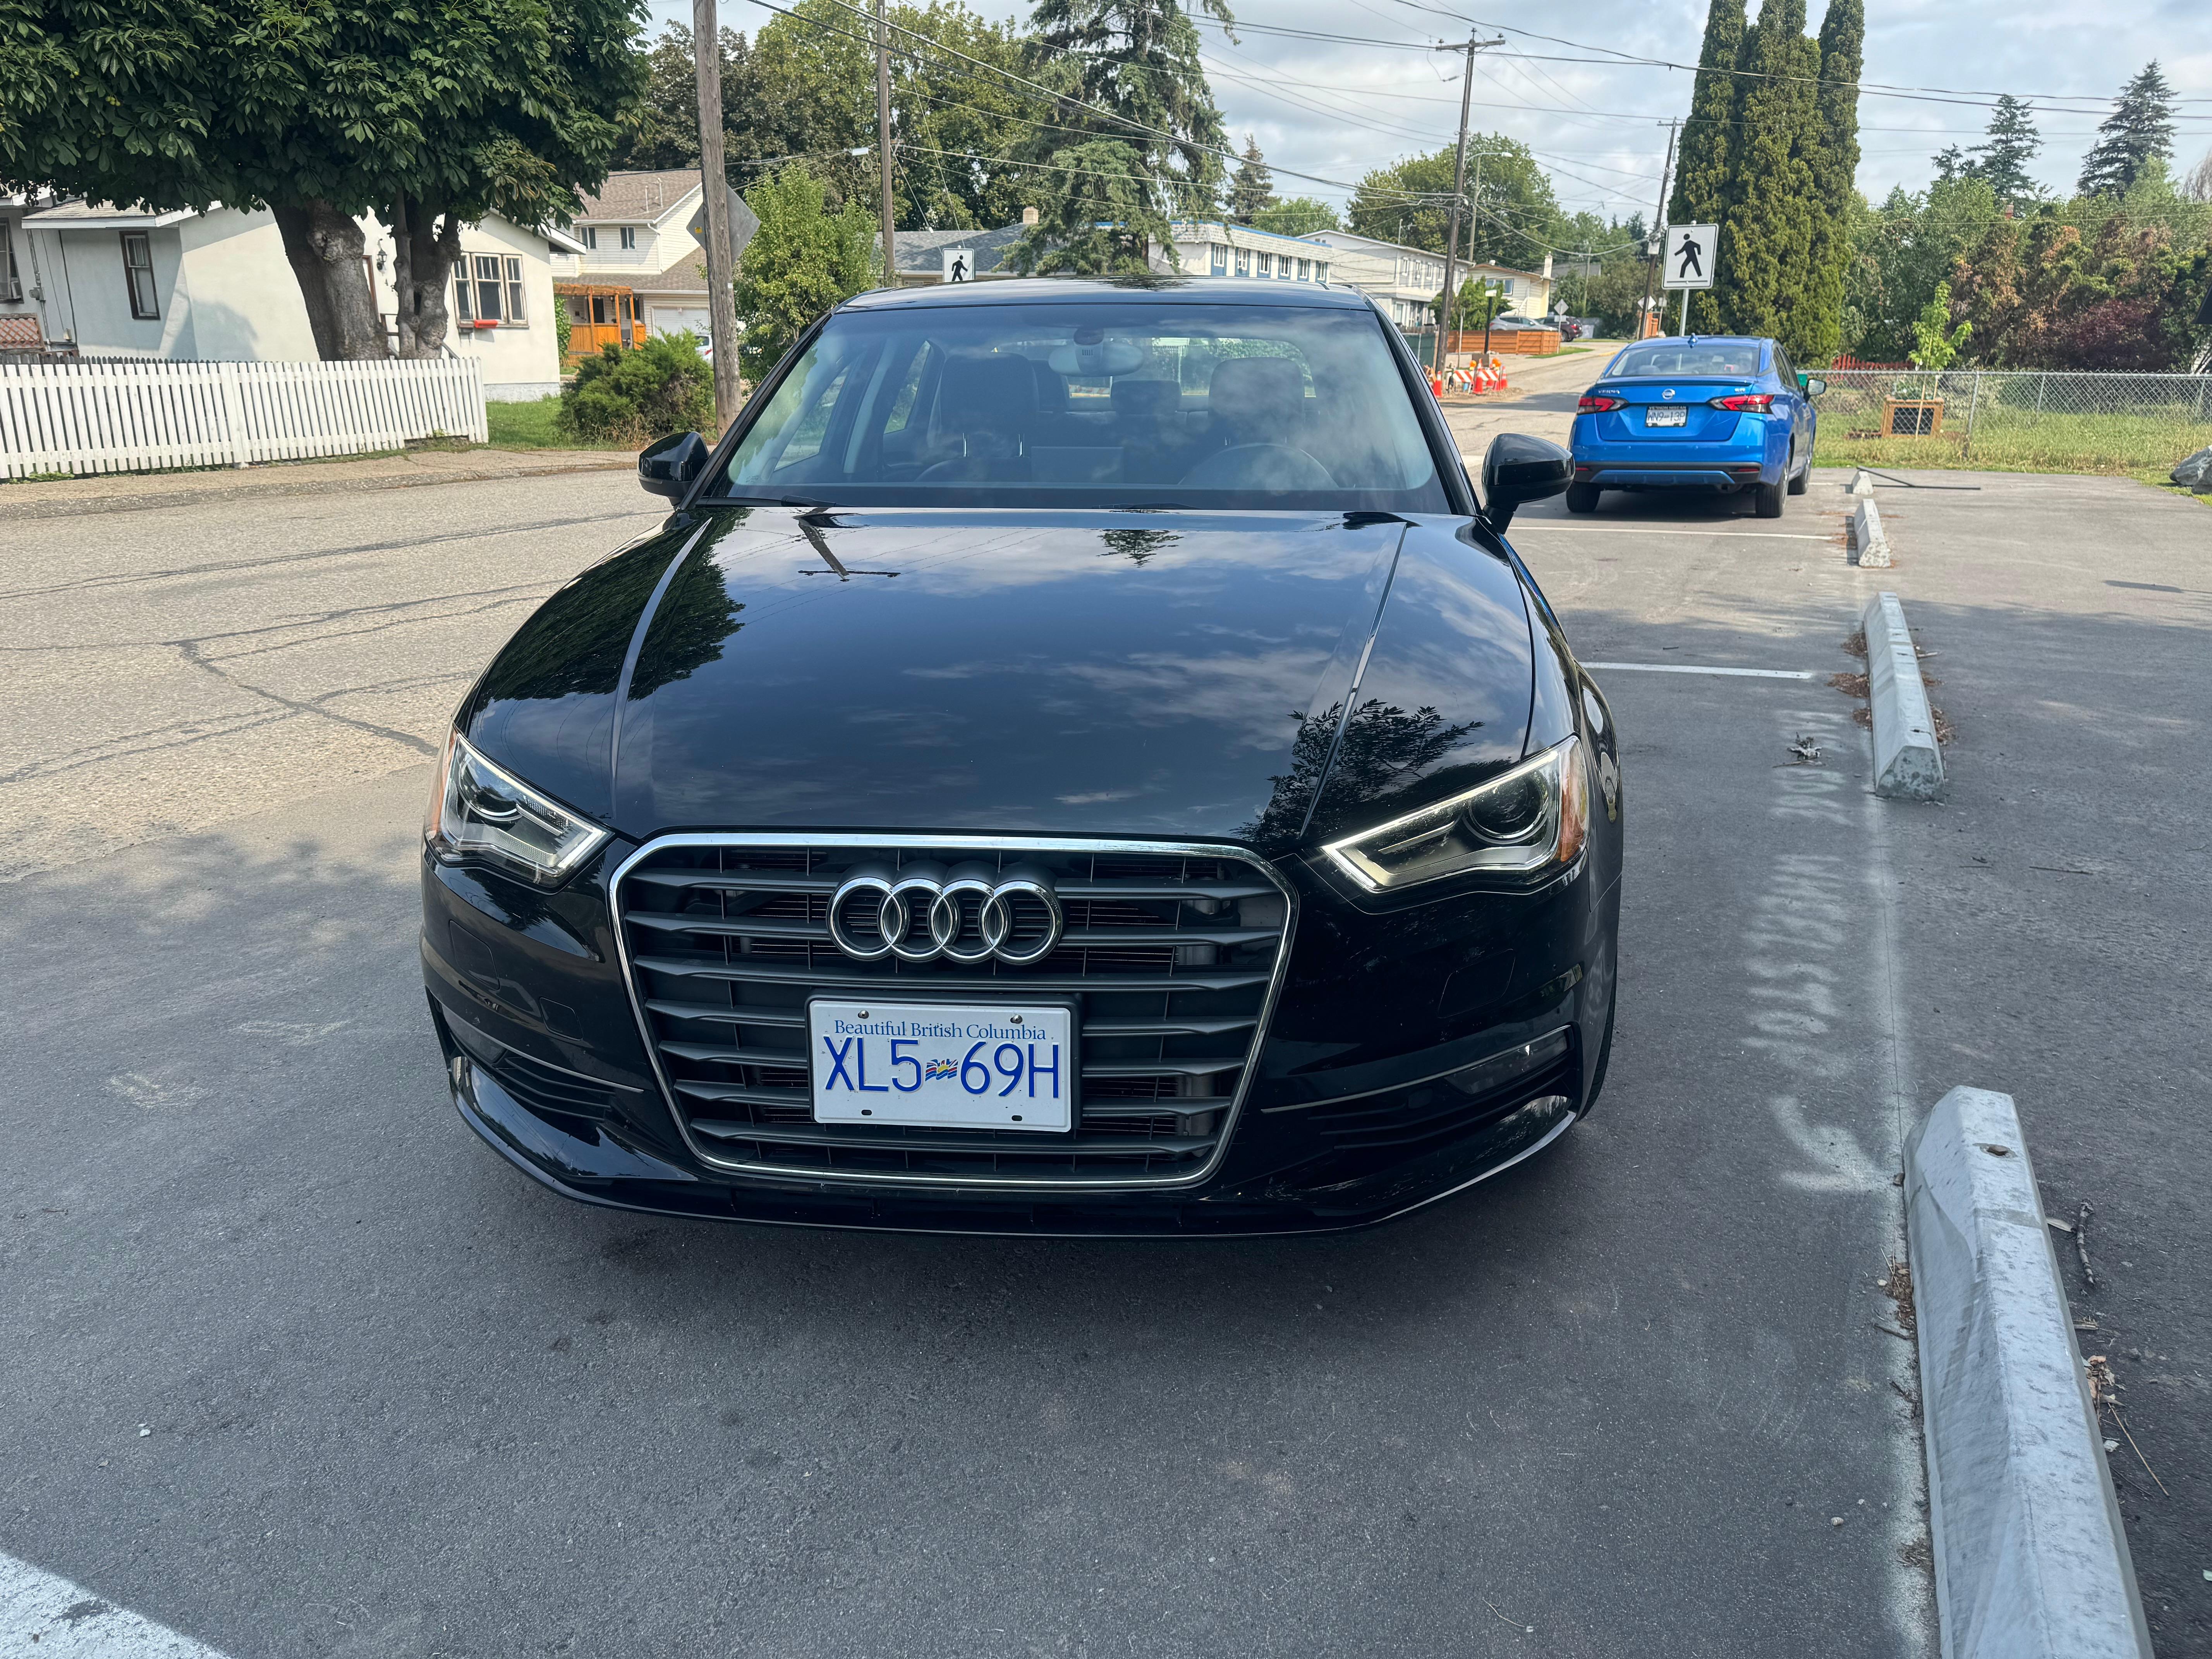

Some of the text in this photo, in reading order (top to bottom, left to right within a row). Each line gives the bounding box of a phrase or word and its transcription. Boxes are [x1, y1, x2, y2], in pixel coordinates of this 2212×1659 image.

[835, 1020, 1046, 1040] Beautiful British Columbia
[823, 1036, 1059, 1099] XL5 69H
